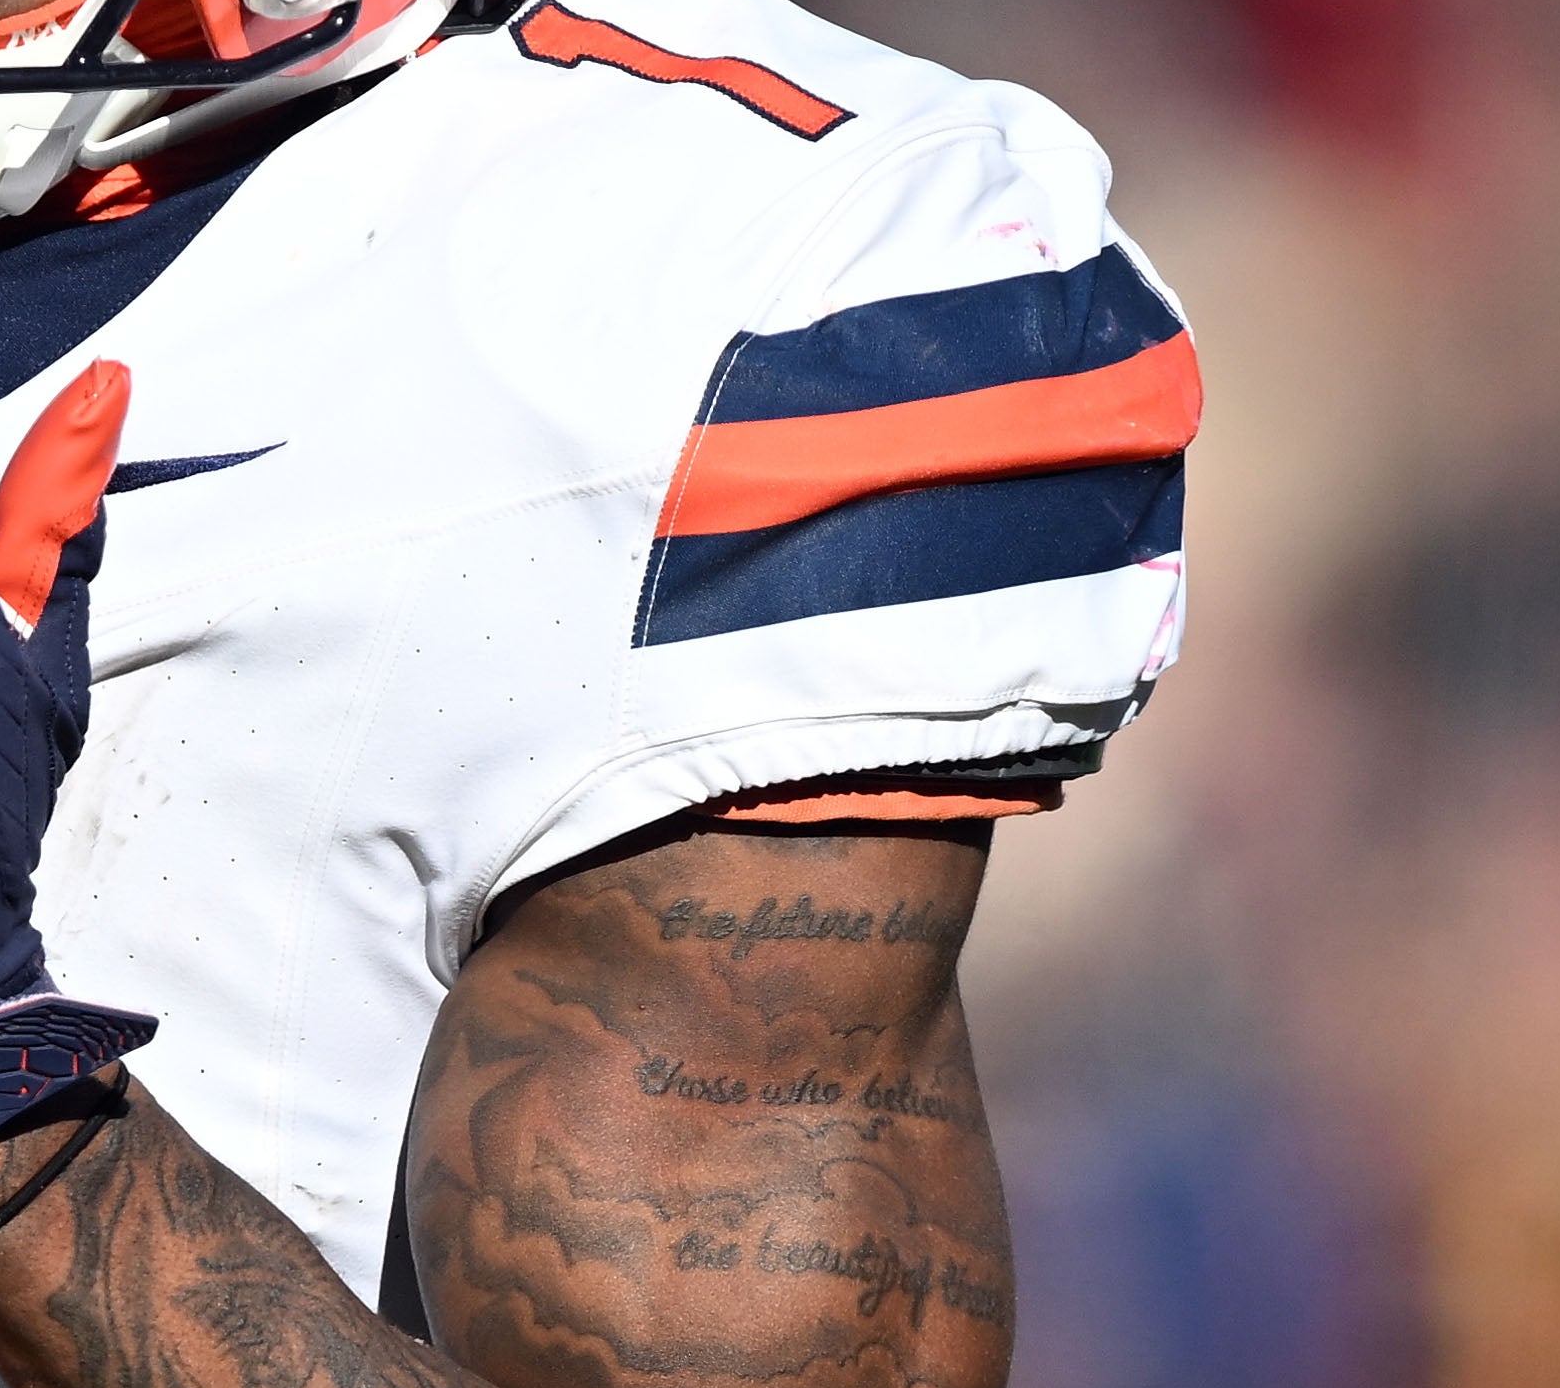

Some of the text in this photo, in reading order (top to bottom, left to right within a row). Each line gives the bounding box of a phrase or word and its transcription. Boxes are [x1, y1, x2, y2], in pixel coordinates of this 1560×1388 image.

[731, 894, 874, 961] future
[633, 1056, 750, 1105] those
[758, 1066, 843, 1106] who
[676, 1229, 741, 1272] the
